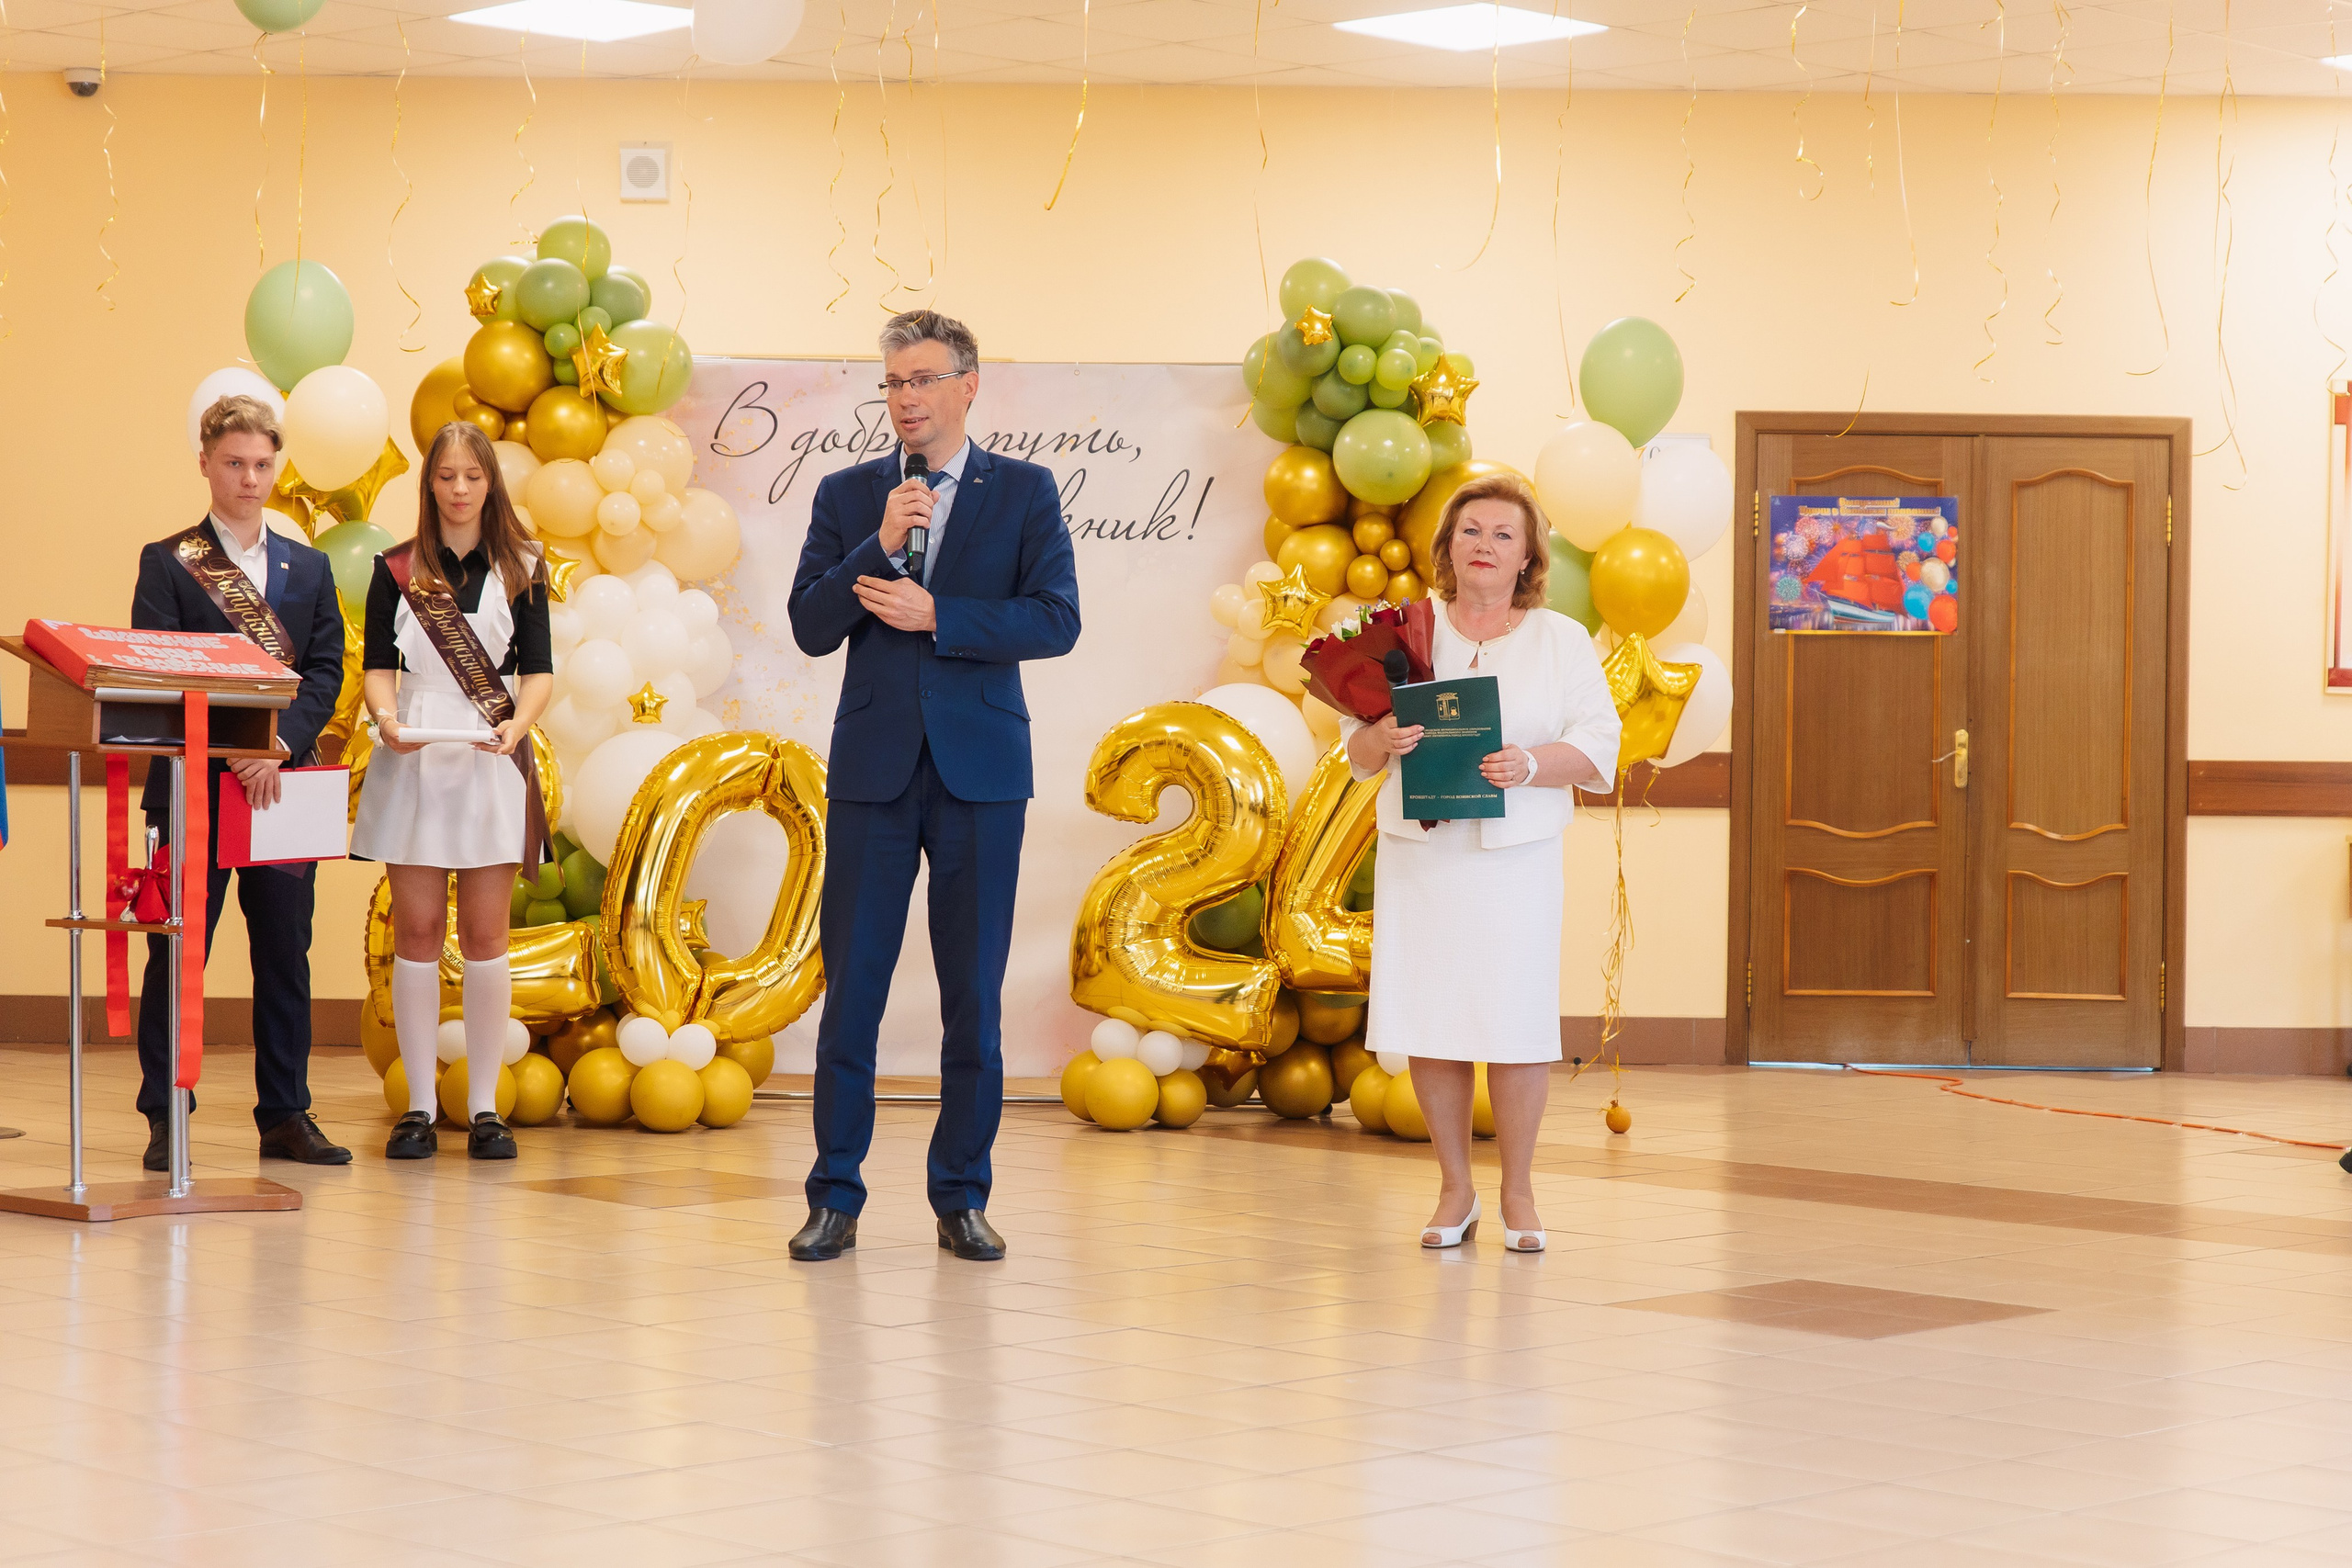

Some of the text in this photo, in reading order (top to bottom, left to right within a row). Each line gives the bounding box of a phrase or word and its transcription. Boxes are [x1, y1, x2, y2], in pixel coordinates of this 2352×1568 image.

[710, 380, 1142, 504] В добр путь,
[1059, 468, 1215, 540] кник!
[78, 627, 229, 649] ШКОЛЬНЫЕ
[128, 645, 211, 661] ГОДЫ
[424, 595, 494, 697] Выпускница
